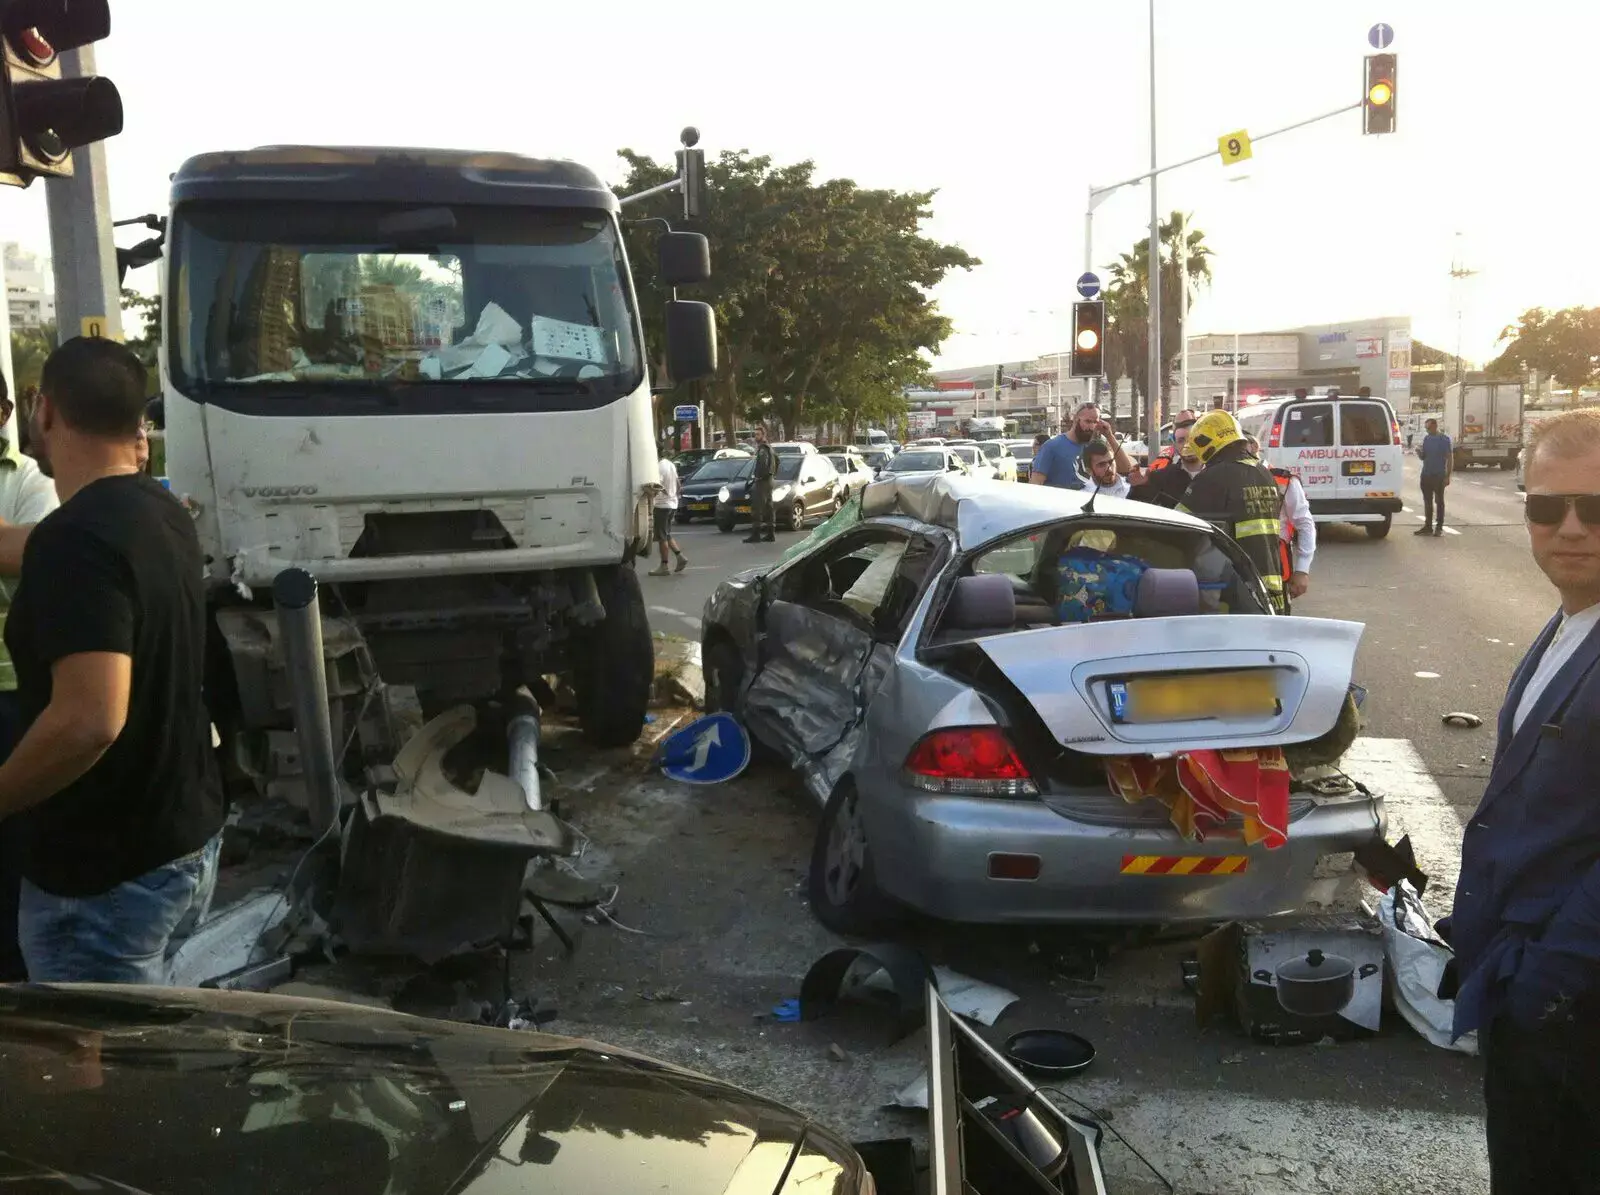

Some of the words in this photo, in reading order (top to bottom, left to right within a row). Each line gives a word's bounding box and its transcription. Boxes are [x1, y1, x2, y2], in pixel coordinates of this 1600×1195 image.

[1228, 138, 1241, 156] 9
[1298, 448, 1376, 459] AMBULANCE
[571, 476, 594, 487] FL
[1309, 475, 1333, 484] לכיש
[1348, 477, 1364, 485] 101
[243, 485, 318, 497] VOLVO
